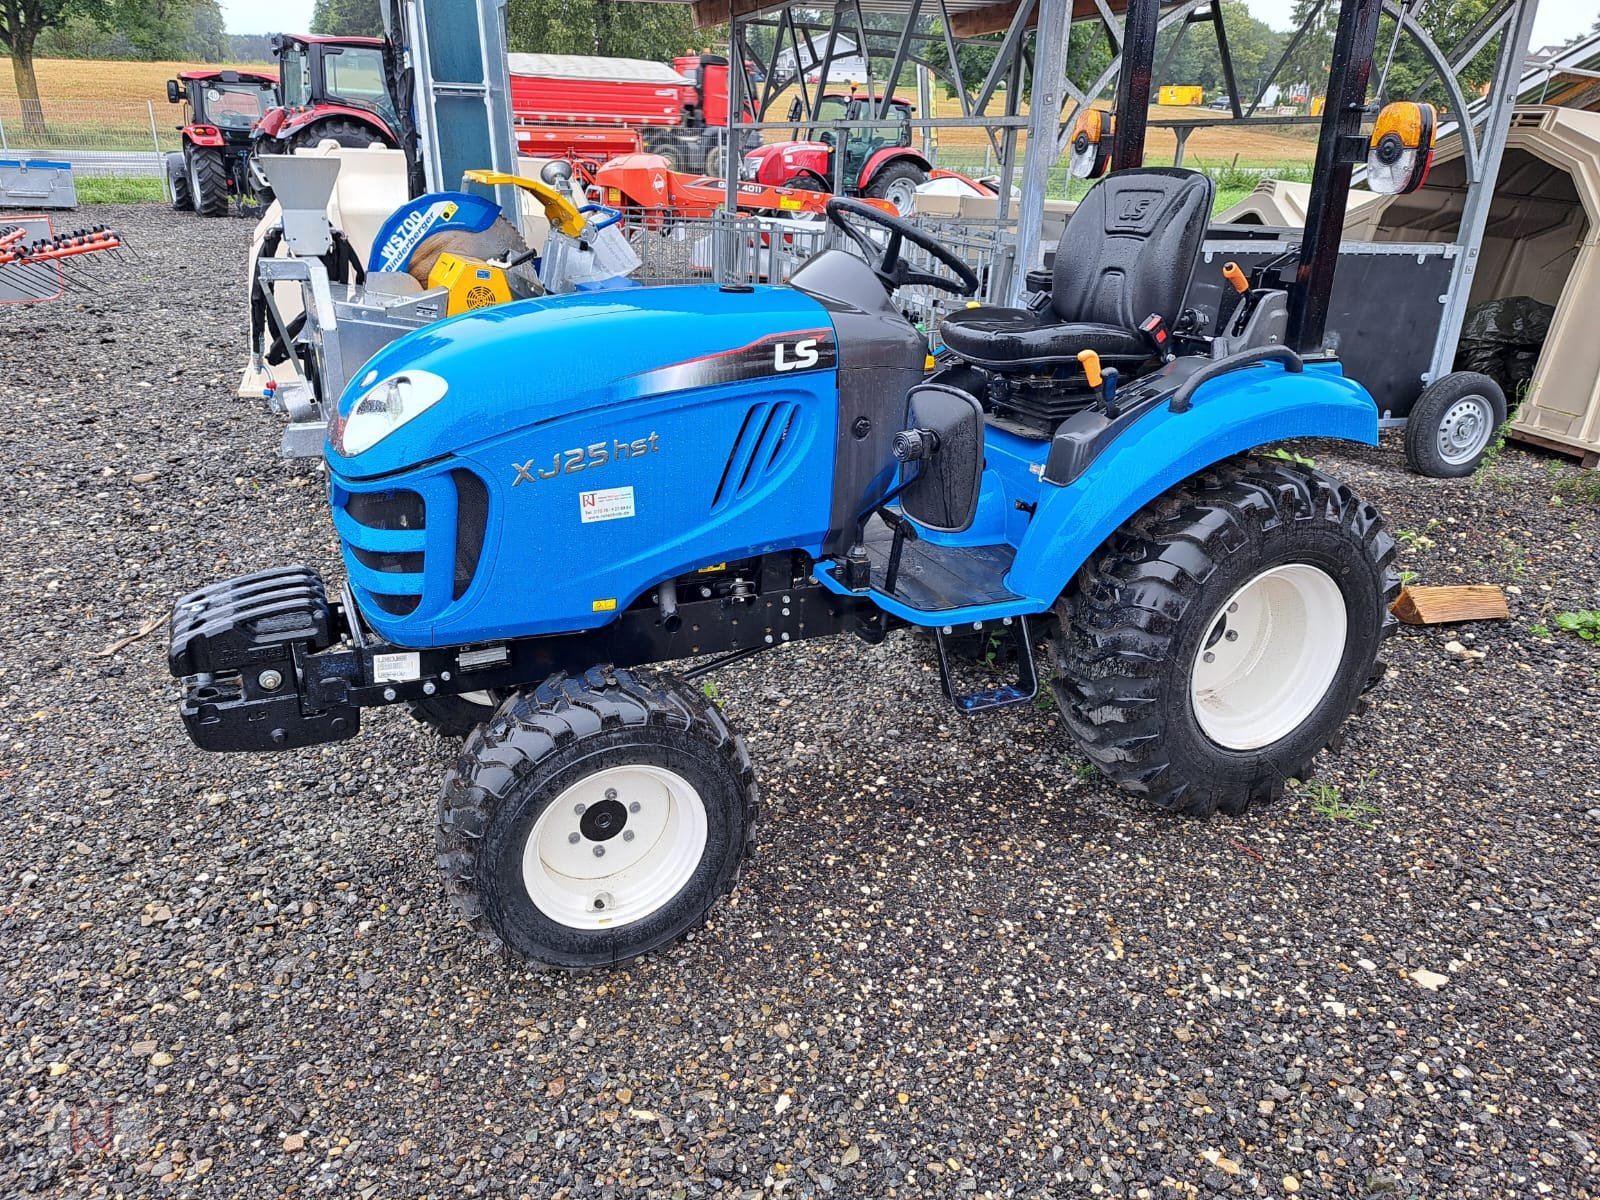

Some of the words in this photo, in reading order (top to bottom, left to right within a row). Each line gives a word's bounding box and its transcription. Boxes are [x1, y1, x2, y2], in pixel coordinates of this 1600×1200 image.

[741, 185, 762, 193] 4011
[1119, 199, 1150, 221] LS
[381, 210, 423, 260] WS700
[385, 212, 435, 272] Binderberger
[774, 339, 819, 372] LS
